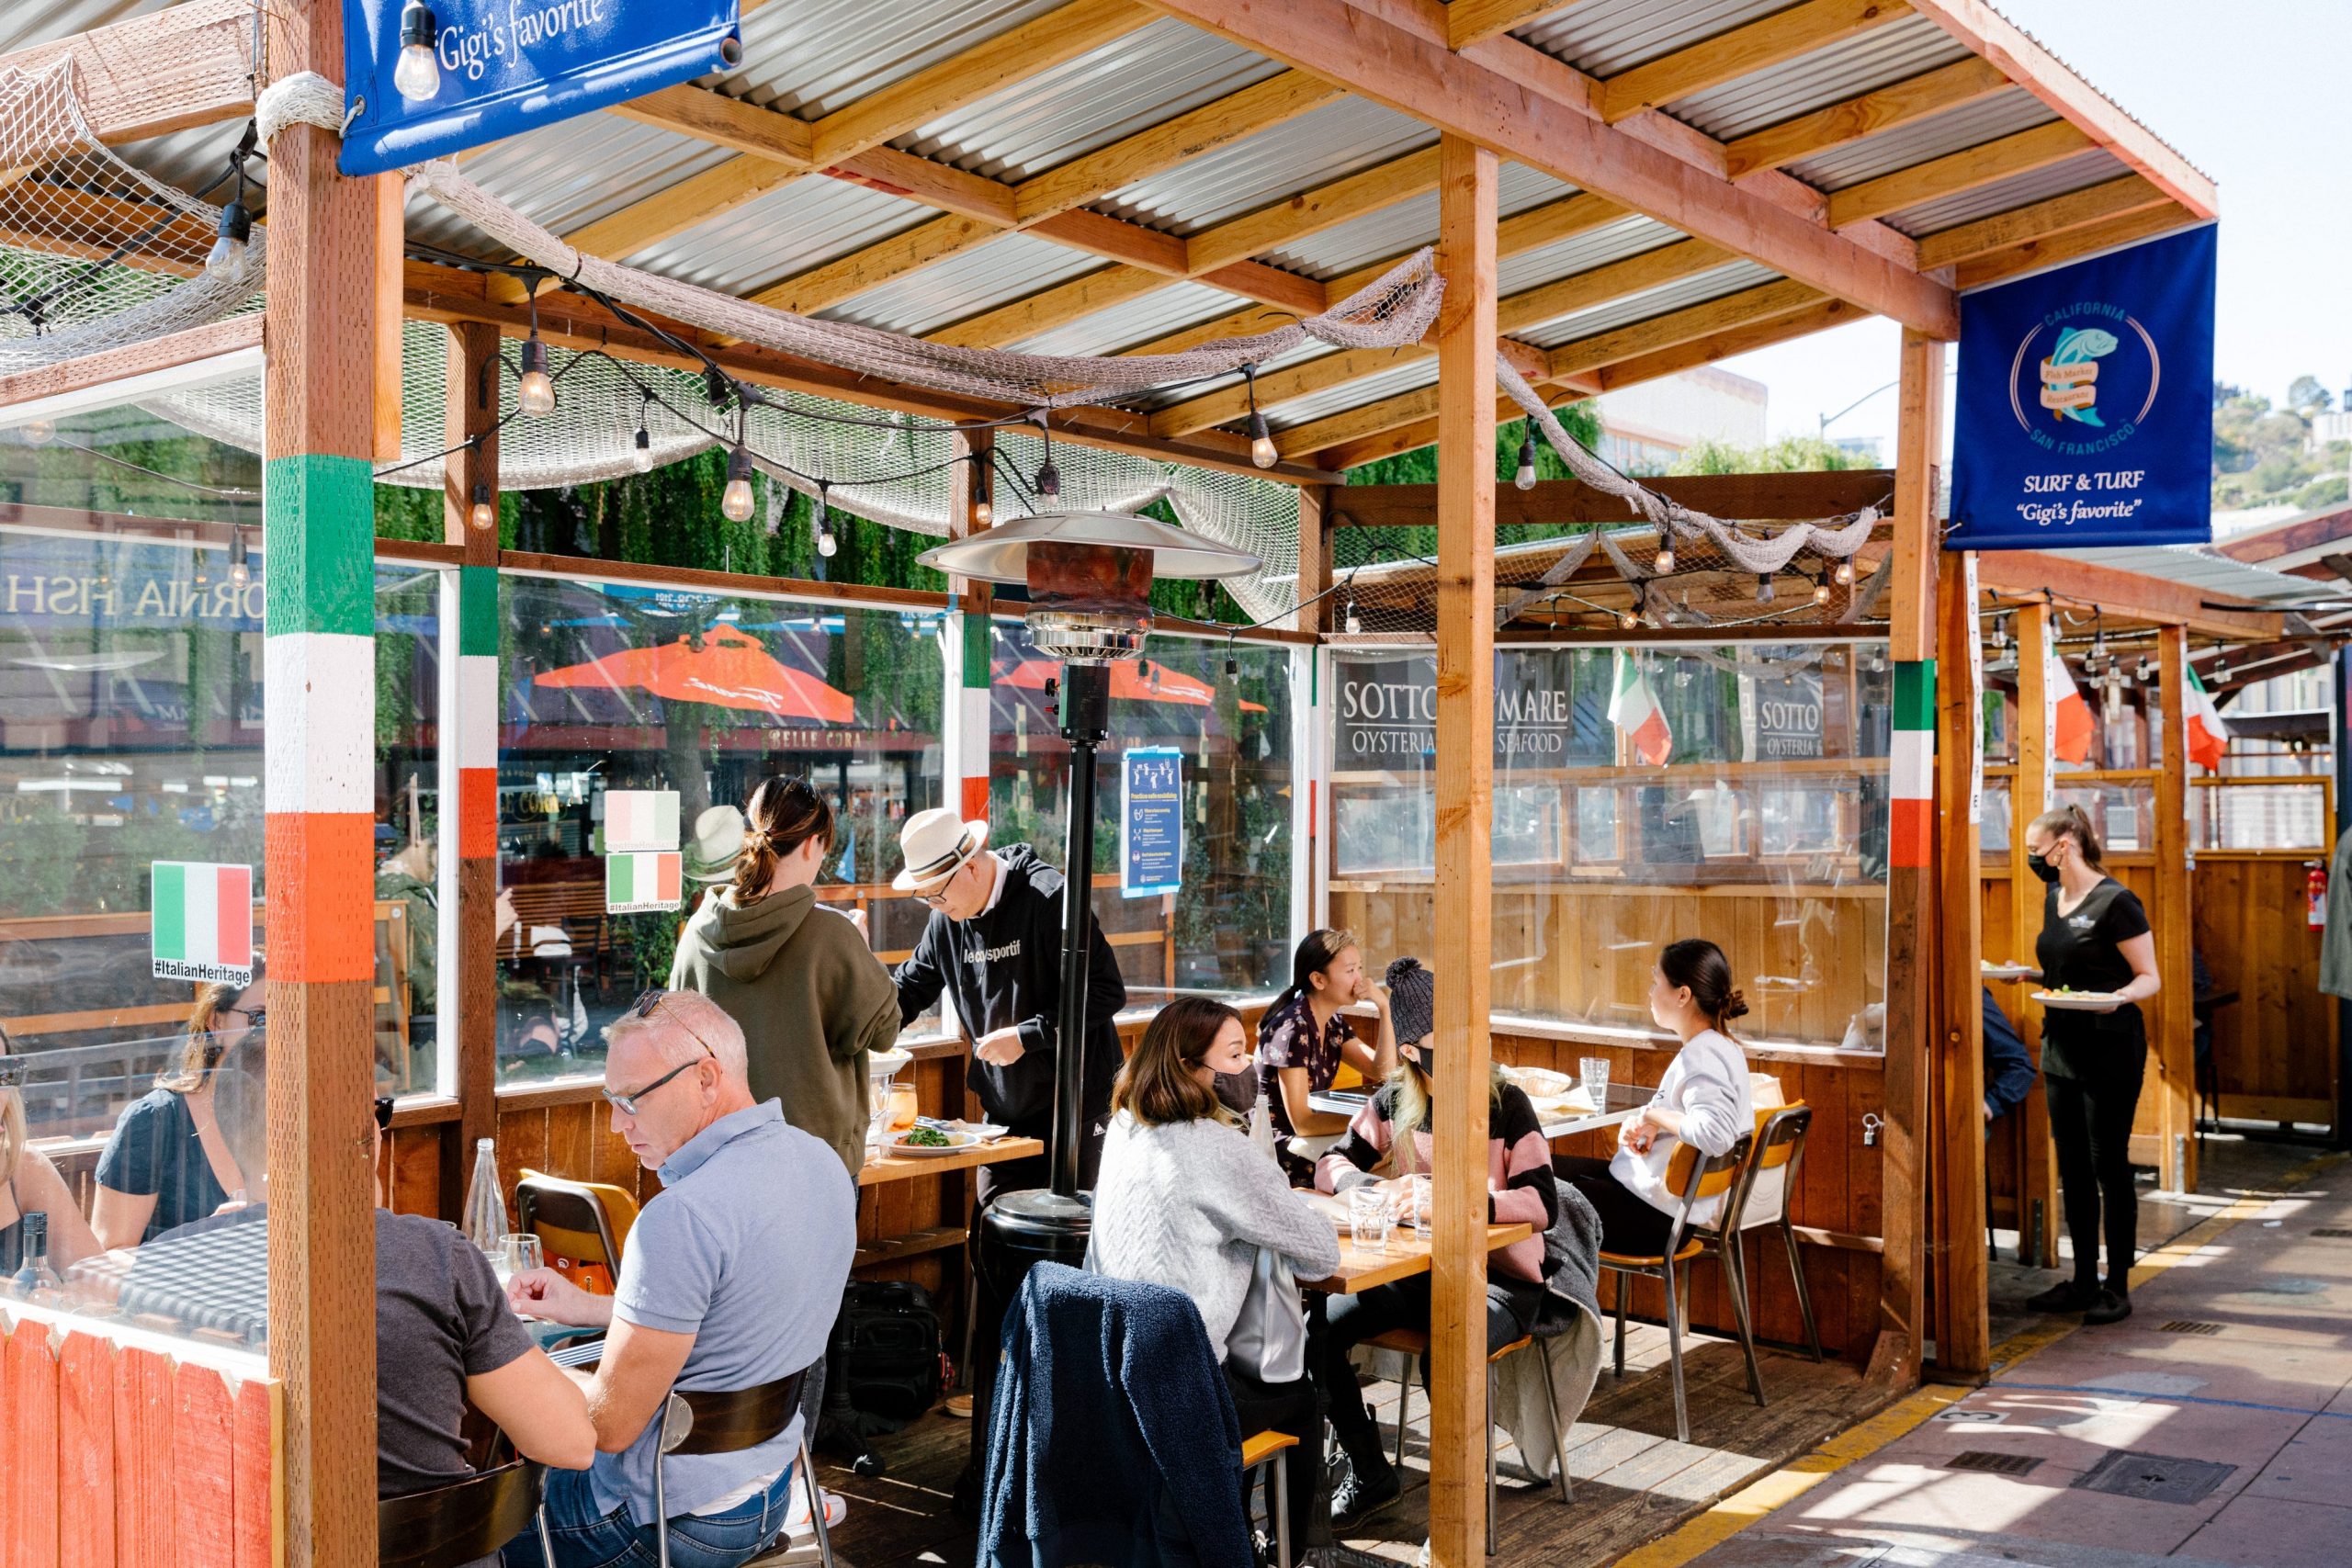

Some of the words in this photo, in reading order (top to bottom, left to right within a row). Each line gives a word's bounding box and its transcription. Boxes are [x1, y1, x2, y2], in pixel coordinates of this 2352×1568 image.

[507, 0, 605, 69] favorite
[2044, 301, 2126, 326] CALIFORNIA
[2030, 428, 2055, 450] SAN
[2057, 422, 2136, 457] FRANCISCO
[2023, 474, 2074, 493] SURF
[2075, 473, 2092, 491] &
[2094, 469, 2145, 490] TURF
[1343, 681, 1438, 720] SOTTO
[1498, 689, 1569, 723] MARE
[1760, 701, 1820, 731] SOTTO
[768, 728, 818, 750] BELLE
[825, 730, 862, 749] CORA
[1351, 730, 1436, 754] OYSTERIA
[1498, 732, 1563, 754] SEAFOOD
[1767, 738, 1815, 756] OYSTERIA
[609, 898, 681, 912] #ItalianHeritage
[153, 960, 251, 985] #ItalianHeritage
